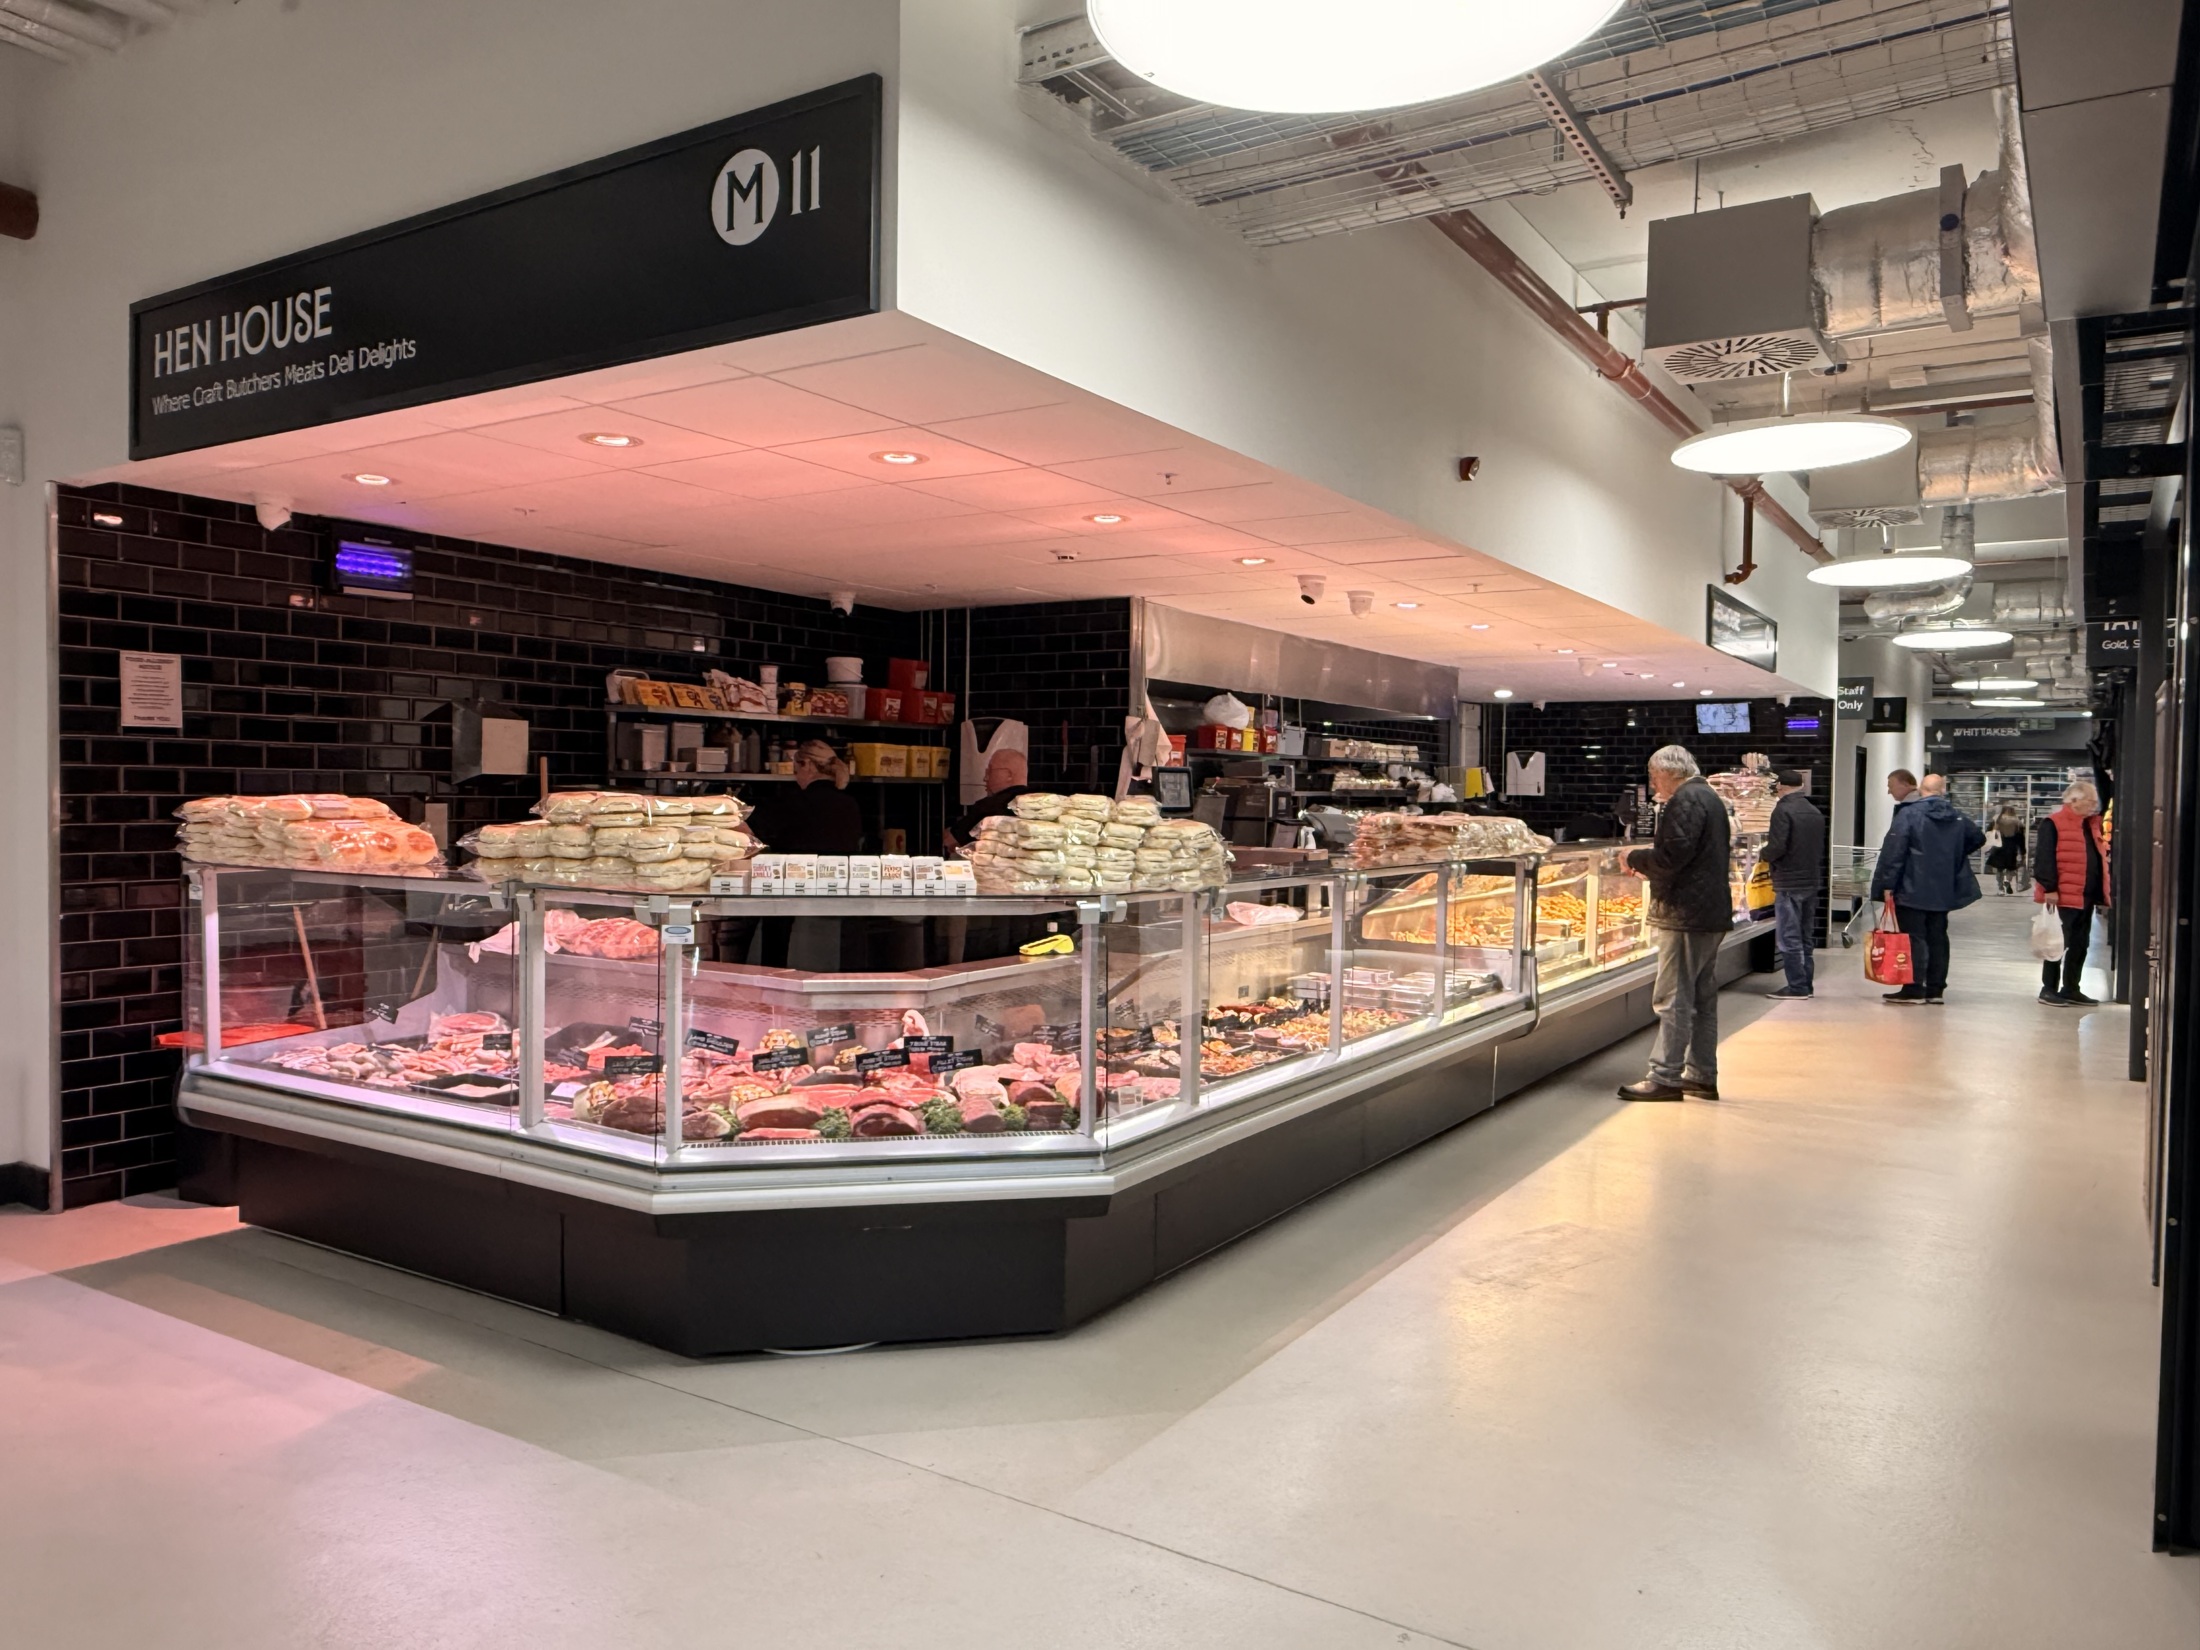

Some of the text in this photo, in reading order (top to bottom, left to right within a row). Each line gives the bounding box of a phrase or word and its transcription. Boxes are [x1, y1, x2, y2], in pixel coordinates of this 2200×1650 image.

[726, 144, 821, 232] M 11
[153, 285, 334, 379] HEN HOUSE
[151, 336, 417, 416] Where Craft Butchers Meats Deli Delights
[2101, 639, 2130, 650] Gold,
[1837, 700, 1864, 712] Only
[1838, 685, 1865, 696] Staff
